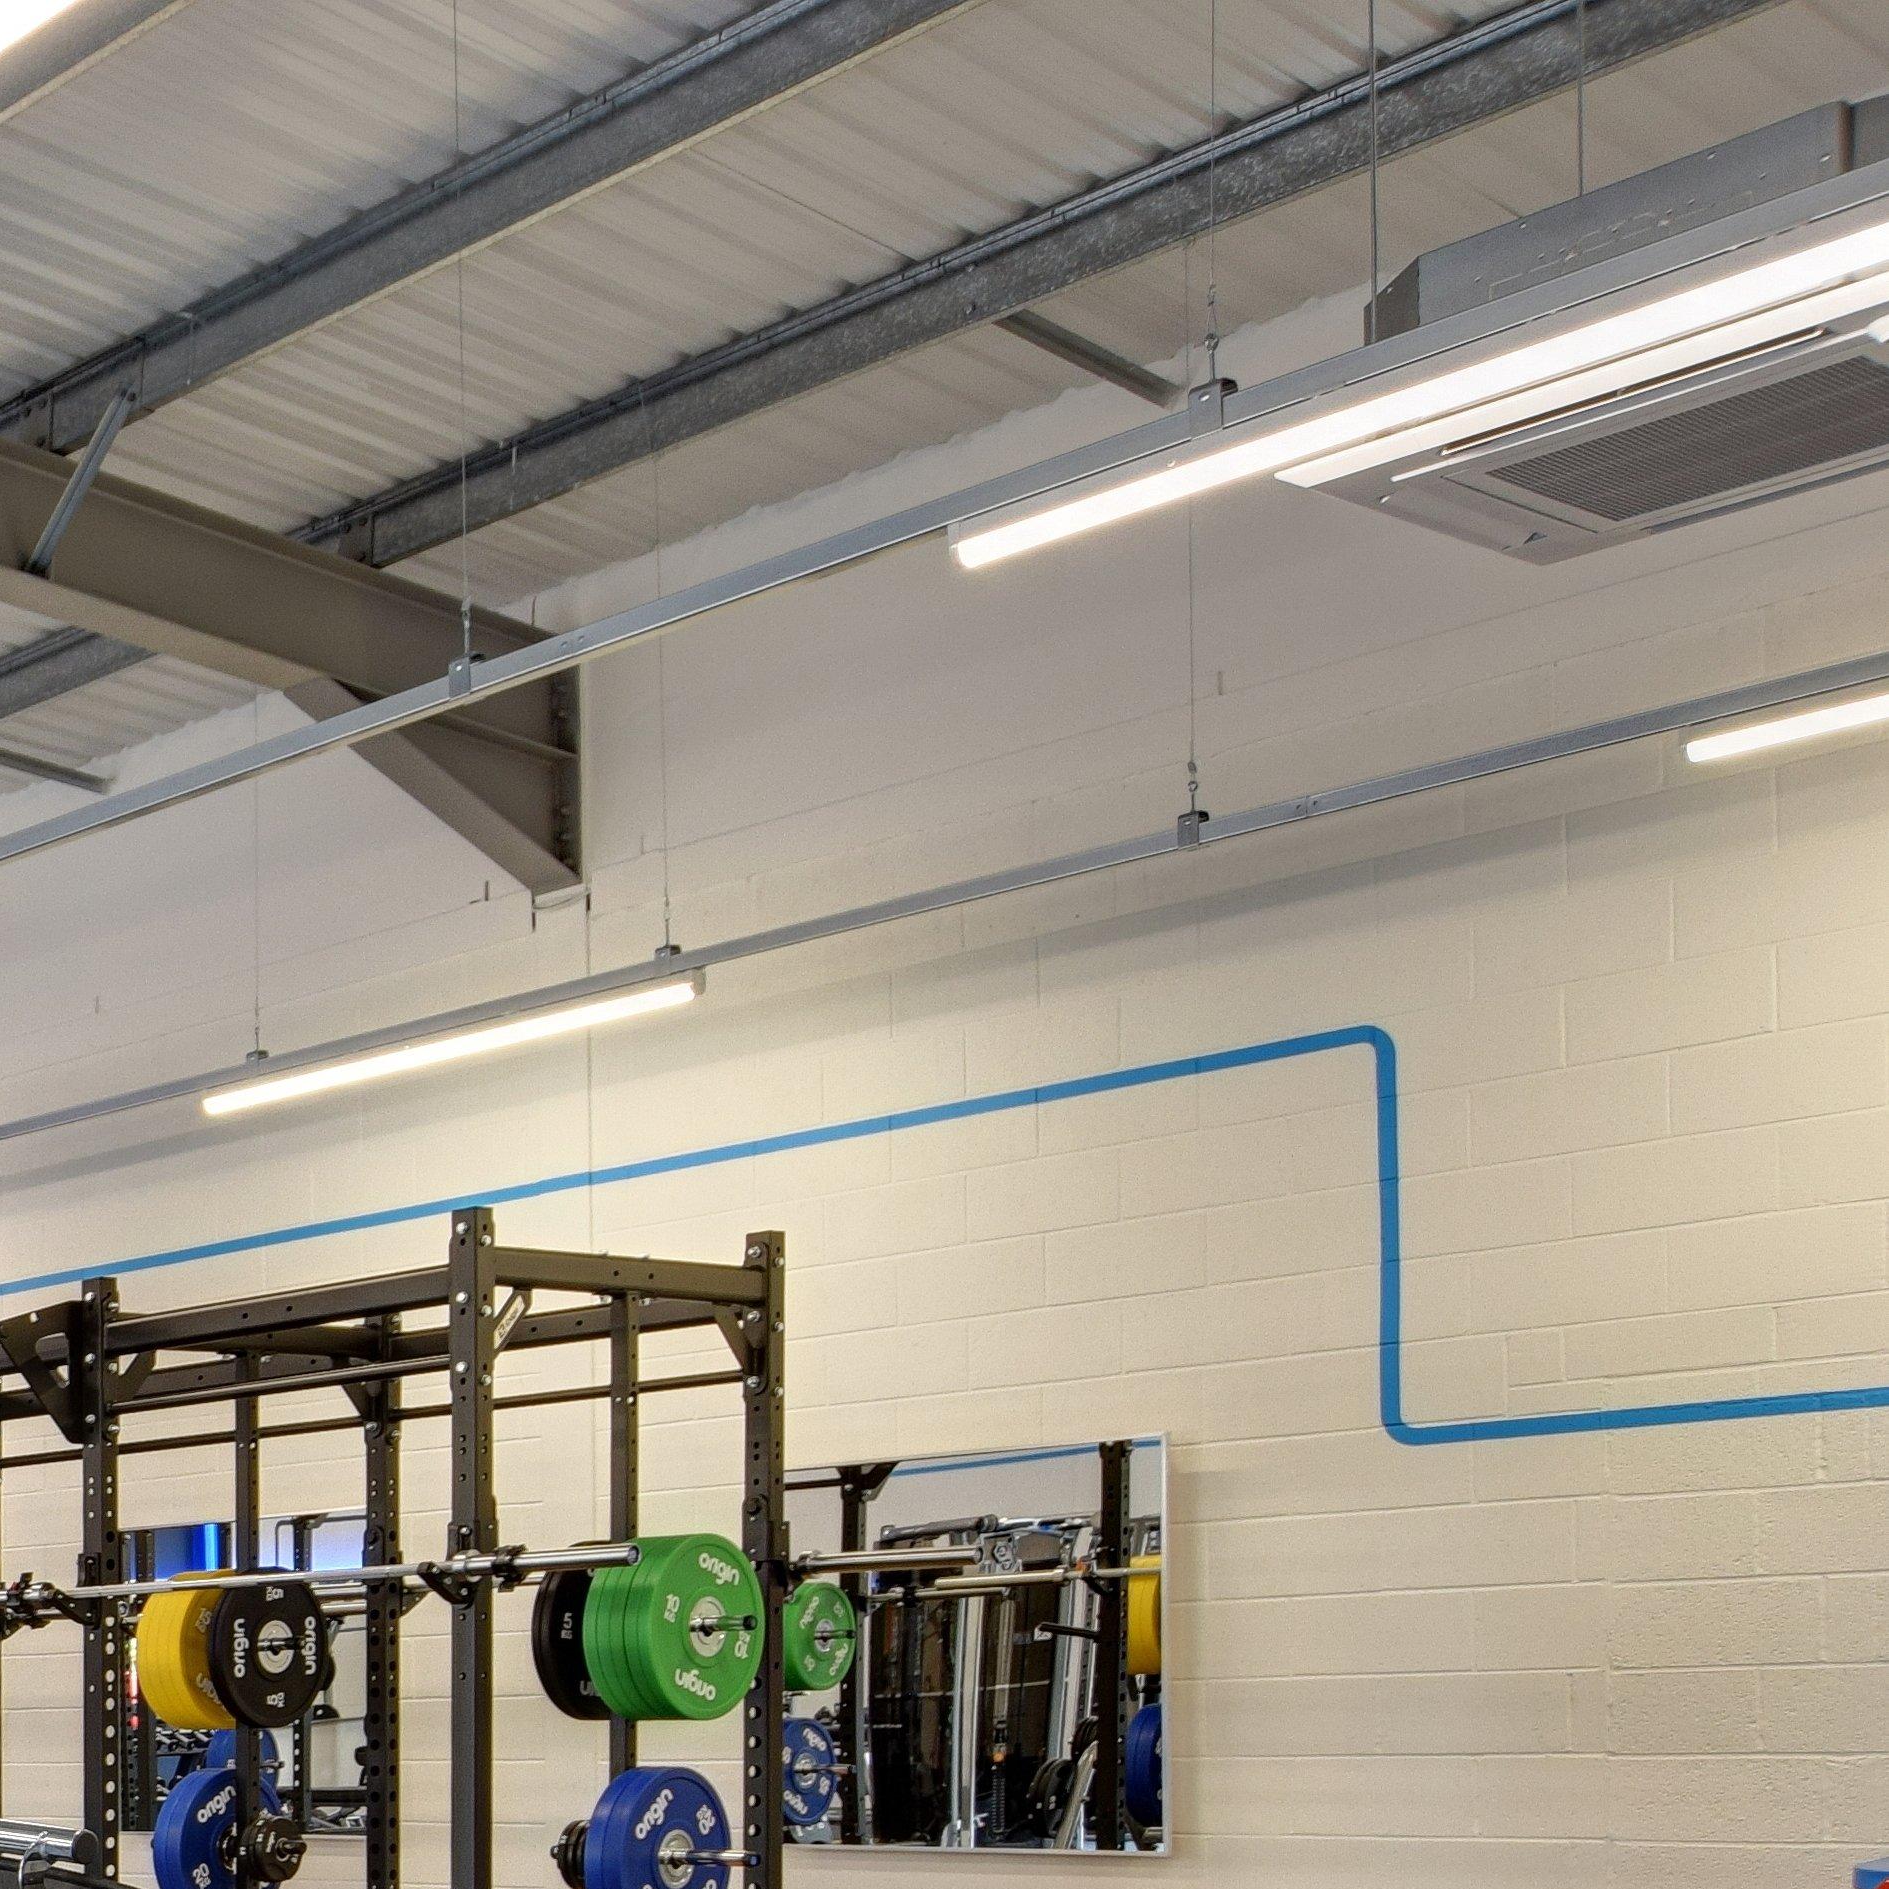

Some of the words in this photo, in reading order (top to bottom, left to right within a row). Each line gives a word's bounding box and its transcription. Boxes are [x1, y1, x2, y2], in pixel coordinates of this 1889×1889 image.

[698, 1552, 740, 1586] origin
[665, 1593, 681, 1612] 10
[233, 1618, 250, 1678] origin
[300, 1616, 317, 1676] origin
[674, 1668, 716, 1701] origin
[196, 1785, 237, 1823] origin
[635, 1788, 674, 1840] origin
[192, 1862, 210, 1884] 20
